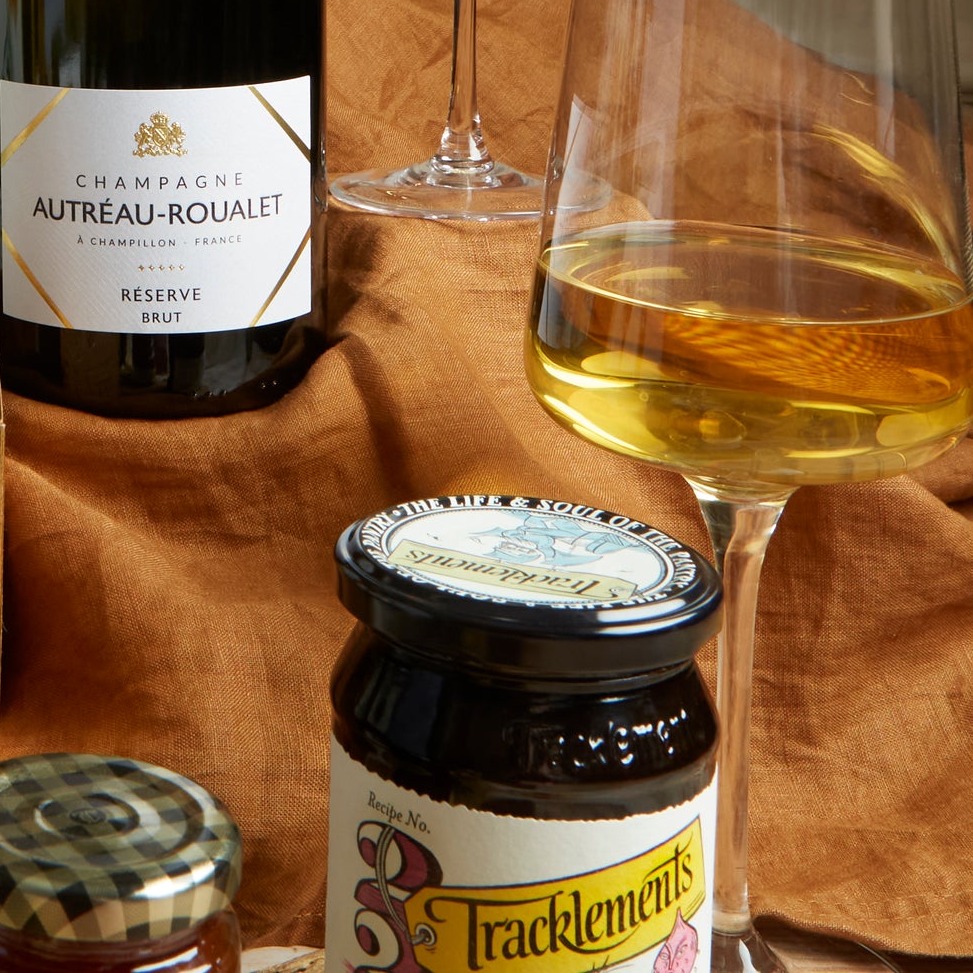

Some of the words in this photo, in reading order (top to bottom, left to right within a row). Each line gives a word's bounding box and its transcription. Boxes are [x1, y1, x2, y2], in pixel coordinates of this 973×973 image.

[76, 172, 243, 190] CHAMPAGNE
[33, 194, 283, 225] AUTRÉAU-ROUALET
[90, 237, 176, 247] CHAMPILLON
[195, 235, 242, 246] FRANCE
[121, 286, 202, 302] RÉSERVE
[142, 312, 182, 323] BRUT
[398, 498, 443, 516] THE
[449, 495, 502, 507] LIFE
[510, 497, 530, 508] &
[537, 499, 606, 522] SOUL
[609, 515, 645, 530] OF
[645, 528, 683, 551] THE
[405, 548, 619, 599] Tracklements
[367, 790, 402, 822] Recipe
[405, 809, 431, 835] No.
[424, 832, 694, 971] Tracklements
